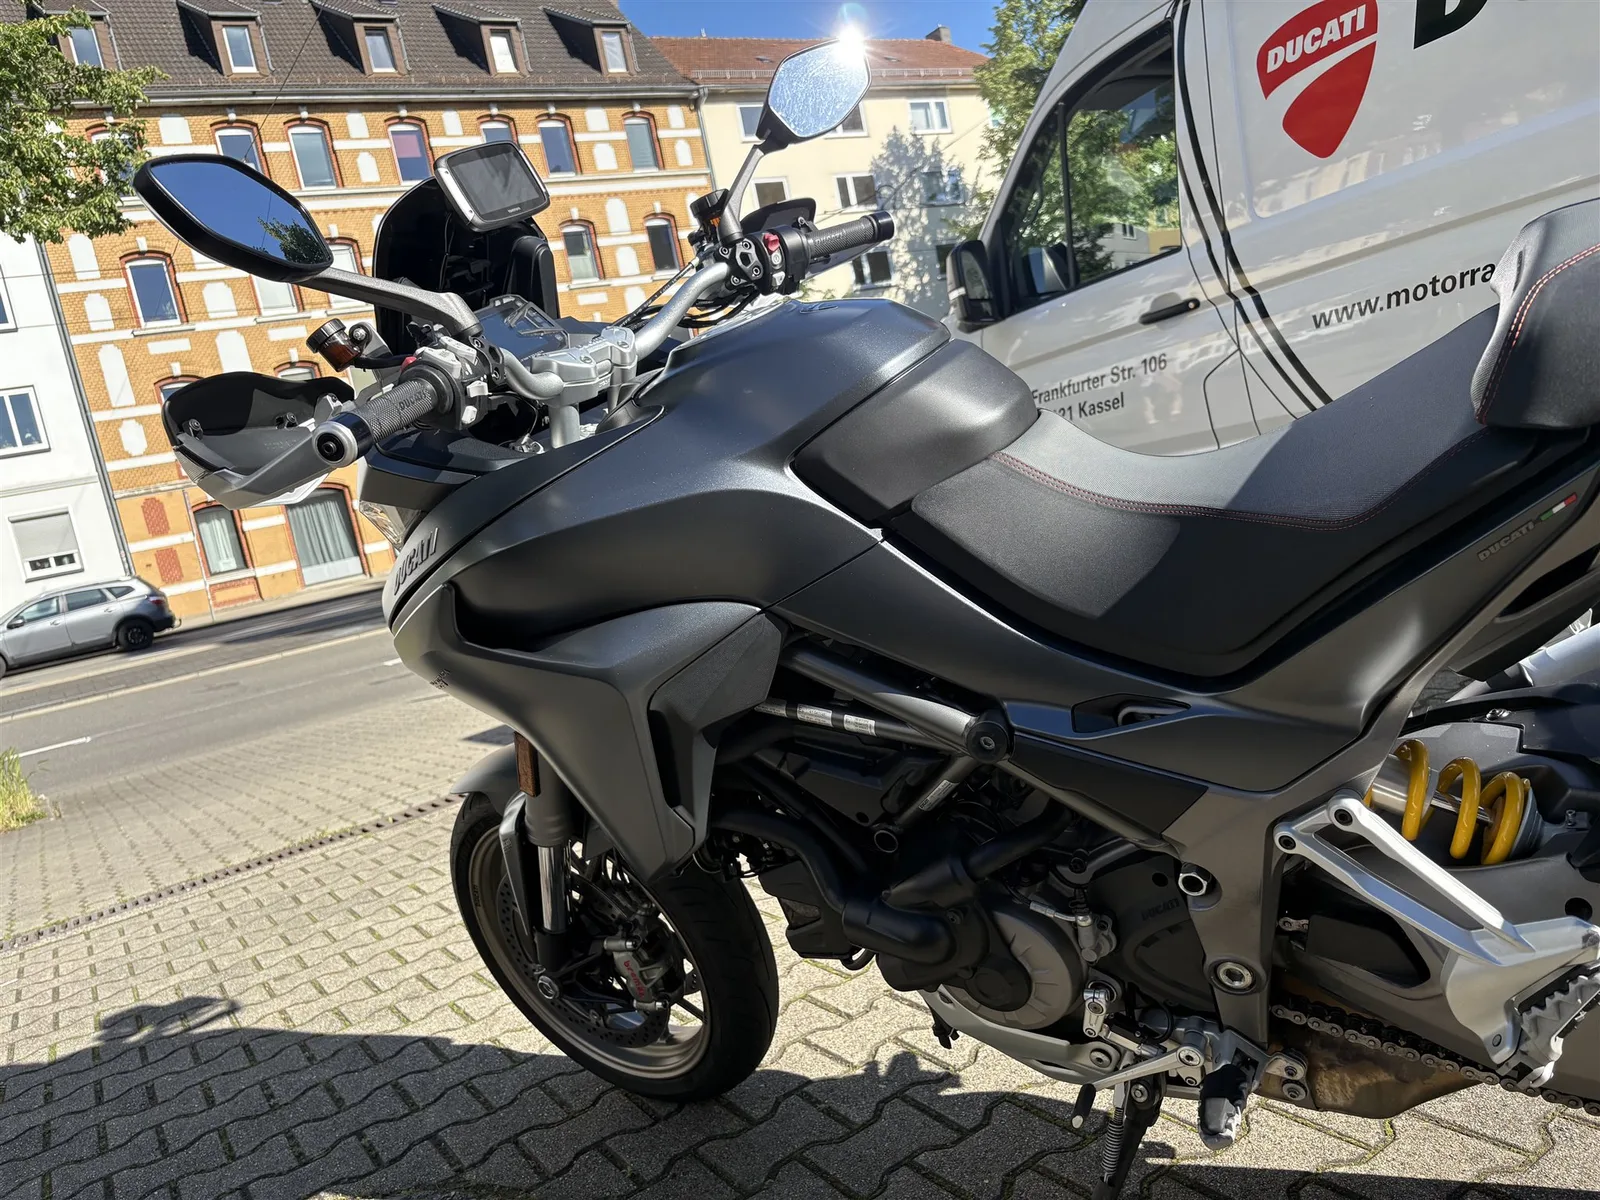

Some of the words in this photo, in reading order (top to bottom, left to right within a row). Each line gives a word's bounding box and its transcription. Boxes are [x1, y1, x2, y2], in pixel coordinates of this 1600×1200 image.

[1266, 4, 1366, 73] DUCATI
[1312, 263, 1496, 329] www.motorra
[1110, 364, 1136, 384] Str.
[1141, 353, 1167, 375] 106
[1079, 391, 1124, 418] Kassel
[1477, 519, 1536, 562] DUCATI
